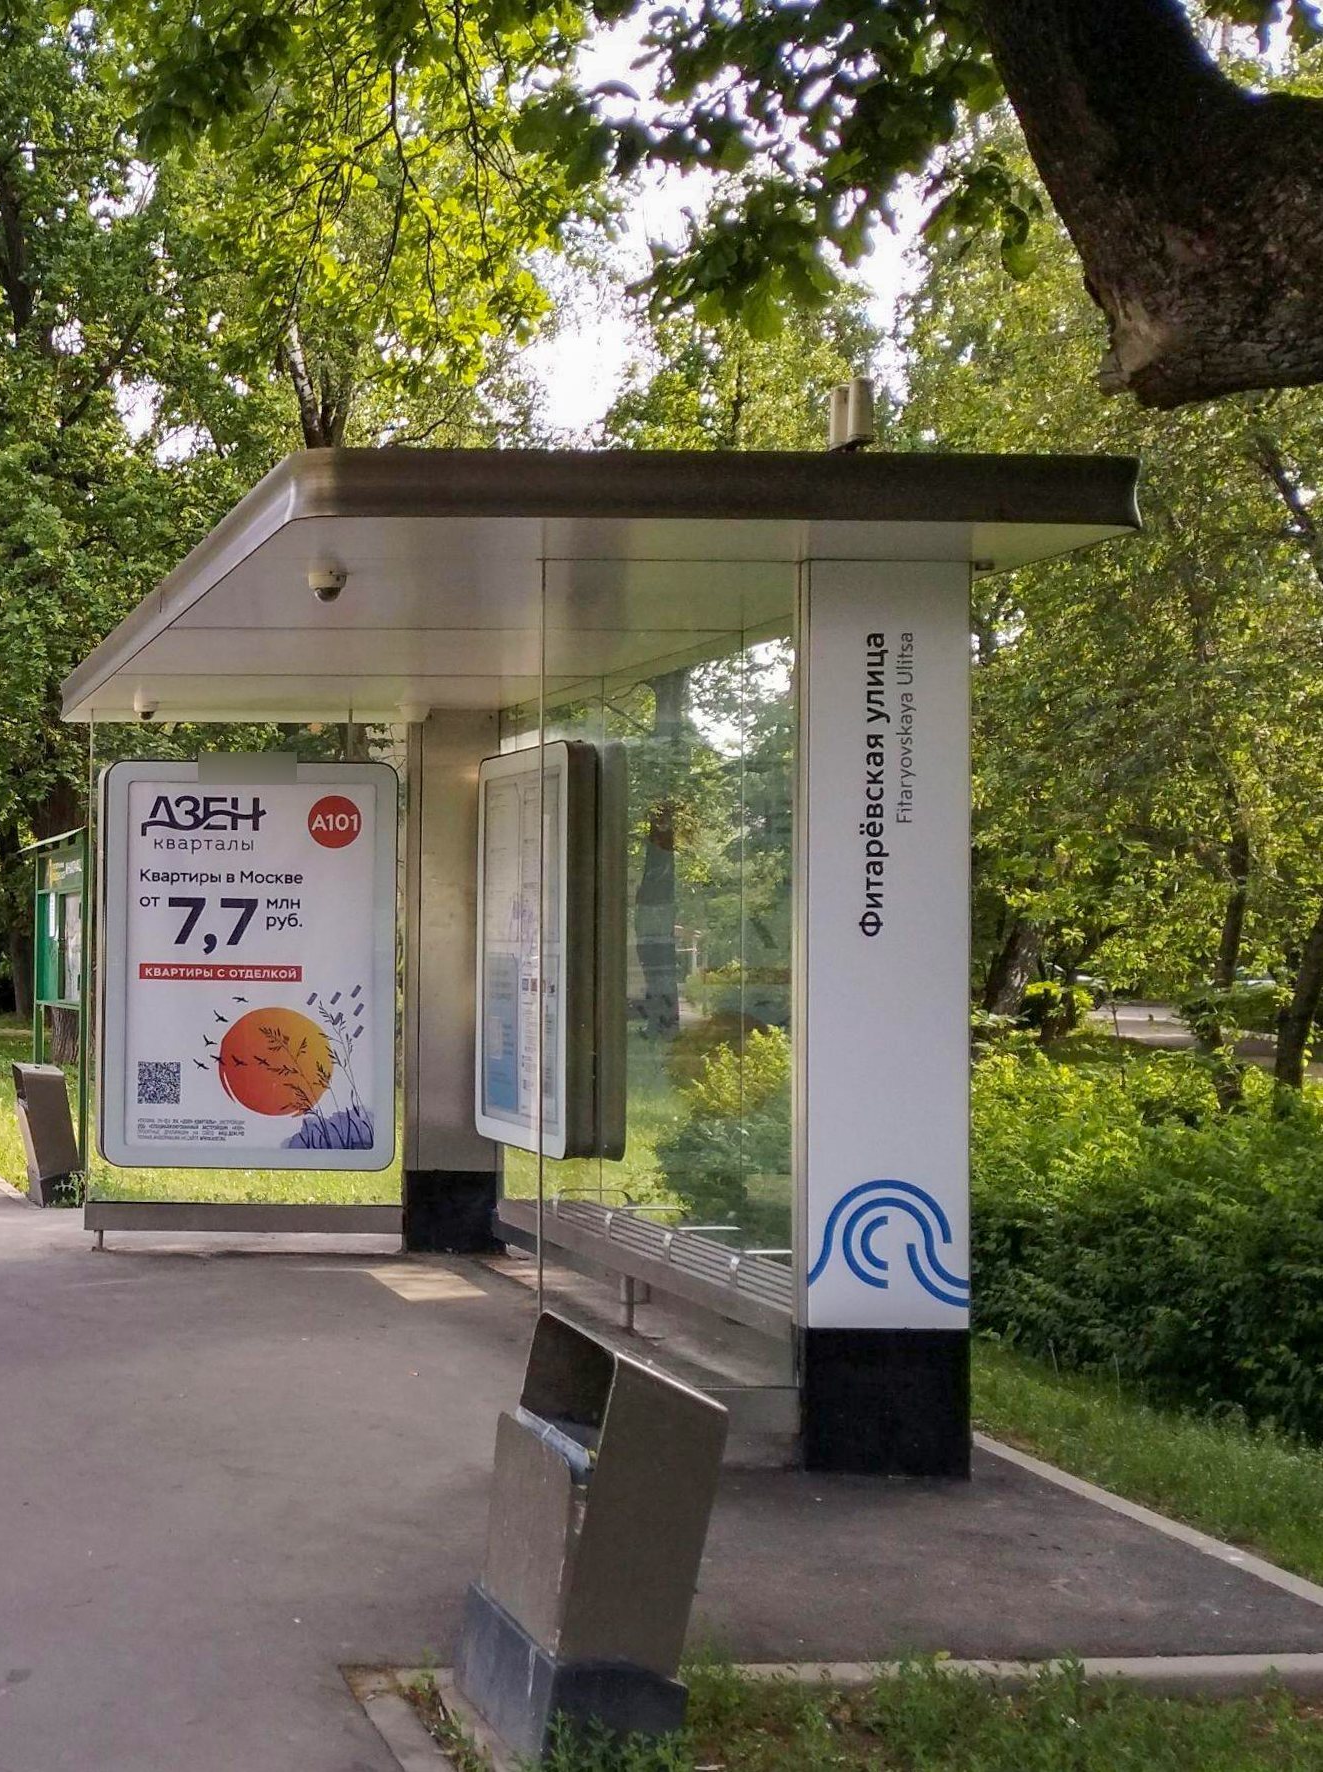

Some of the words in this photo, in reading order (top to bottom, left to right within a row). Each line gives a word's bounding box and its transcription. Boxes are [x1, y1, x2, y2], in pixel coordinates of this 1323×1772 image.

[866, 632, 890, 724] улица
[896, 631, 913, 685] Ulitsa
[896, 692, 917, 823] Fitaryovskaya
[141, 795, 267, 836] ДЗЕН
[859, 734, 889, 937] Фитарёвская
[153, 837, 255, 854] кварталы
[139, 868, 222, 886] Квартиры
[226, 874, 235, 883] в
[240, 870, 304, 885] Москве
[139, 896, 161, 907] от
[168, 897, 259, 955] 7,7
[266, 898, 301, 910] млн
[266, 914, 303, 930] руб.
[145, 967, 213, 978] КВАРТИРЫ
[217, 969, 225, 978] С
[229, 969, 297, 979] ОТДЕЛКОЙ
